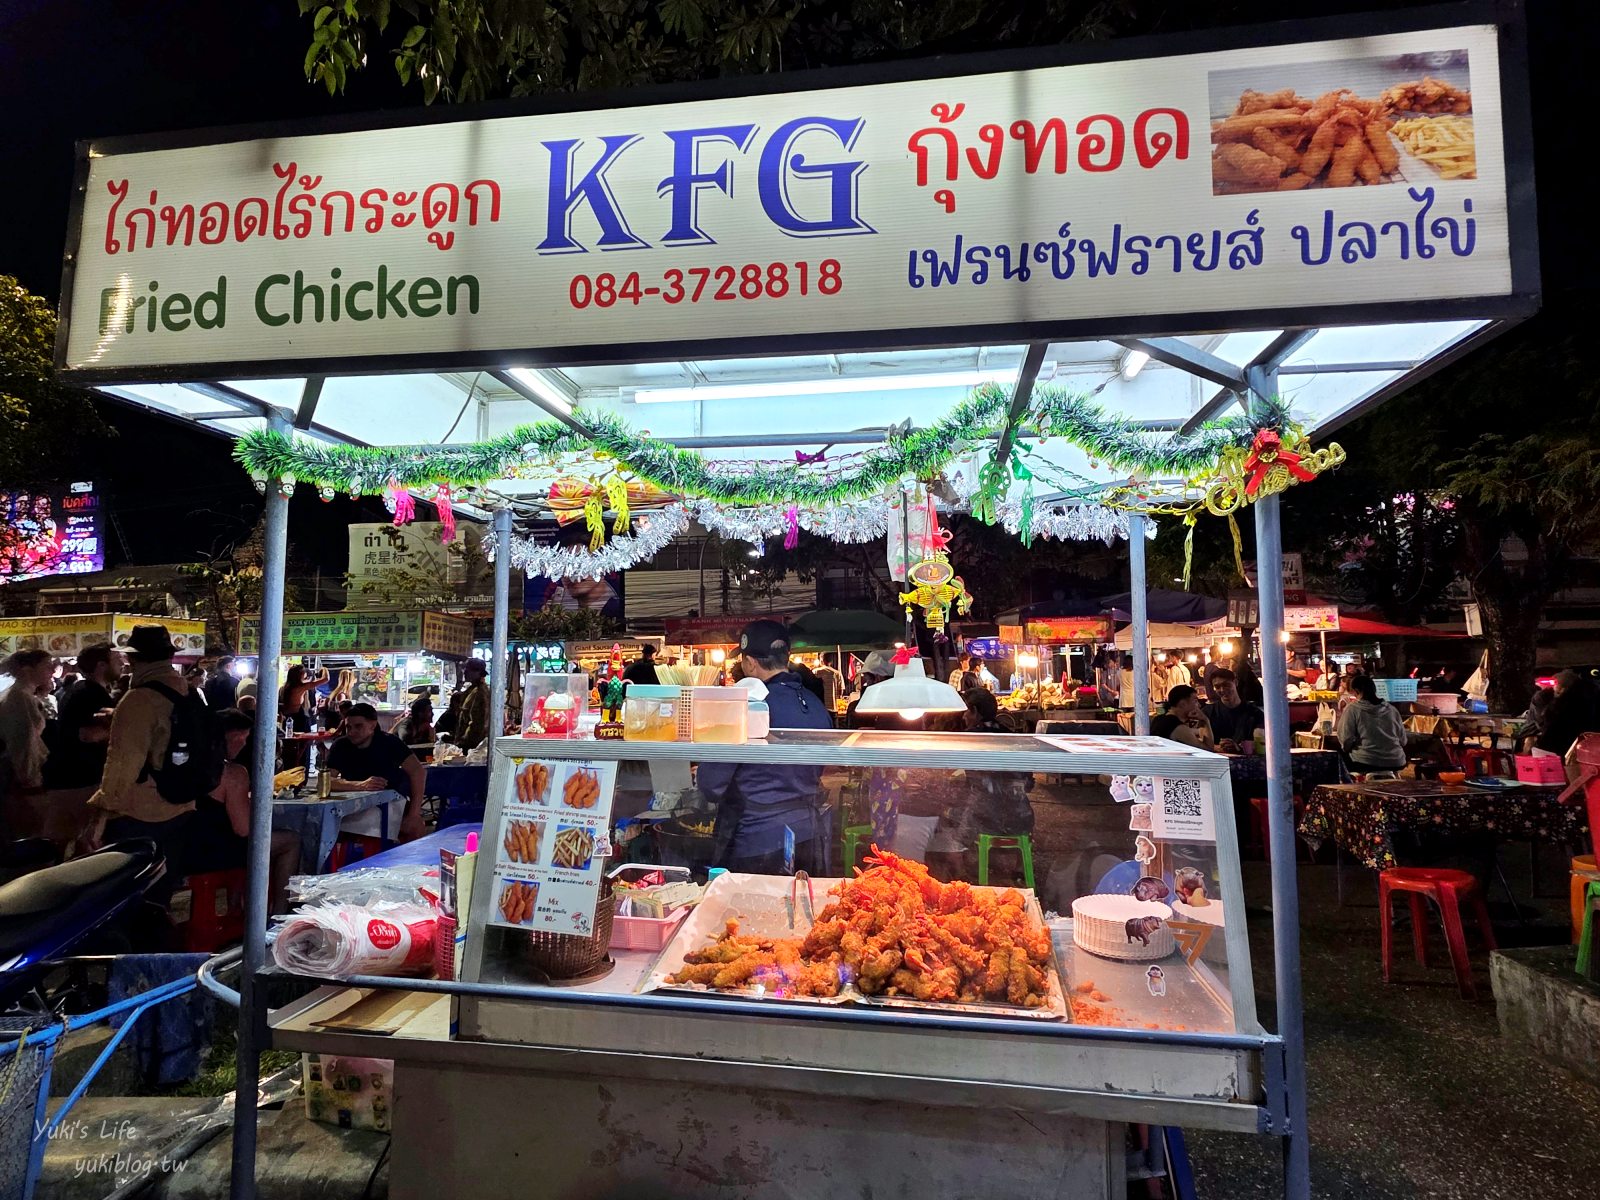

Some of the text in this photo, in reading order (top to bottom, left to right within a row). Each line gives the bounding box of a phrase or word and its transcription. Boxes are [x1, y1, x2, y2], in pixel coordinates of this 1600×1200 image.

[536, 116, 878, 255] KFG
[907, 102, 1190, 214] กุ้งทอด
[105, 162, 501, 254] ไก่ทอดไร้กระดูก
[908, 187, 1476, 289] เฟรนซ์ฟรายส์ ปลาไข่
[98, 264, 480, 336] Fried Chicken
[569, 258, 843, 309] 084-3728818
[39, 617, 77, 627] CHIANG
[80, 616, 98, 626] MAI
[574, 644, 591, 652] Giant
[548, 897, 559, 906] Mix
